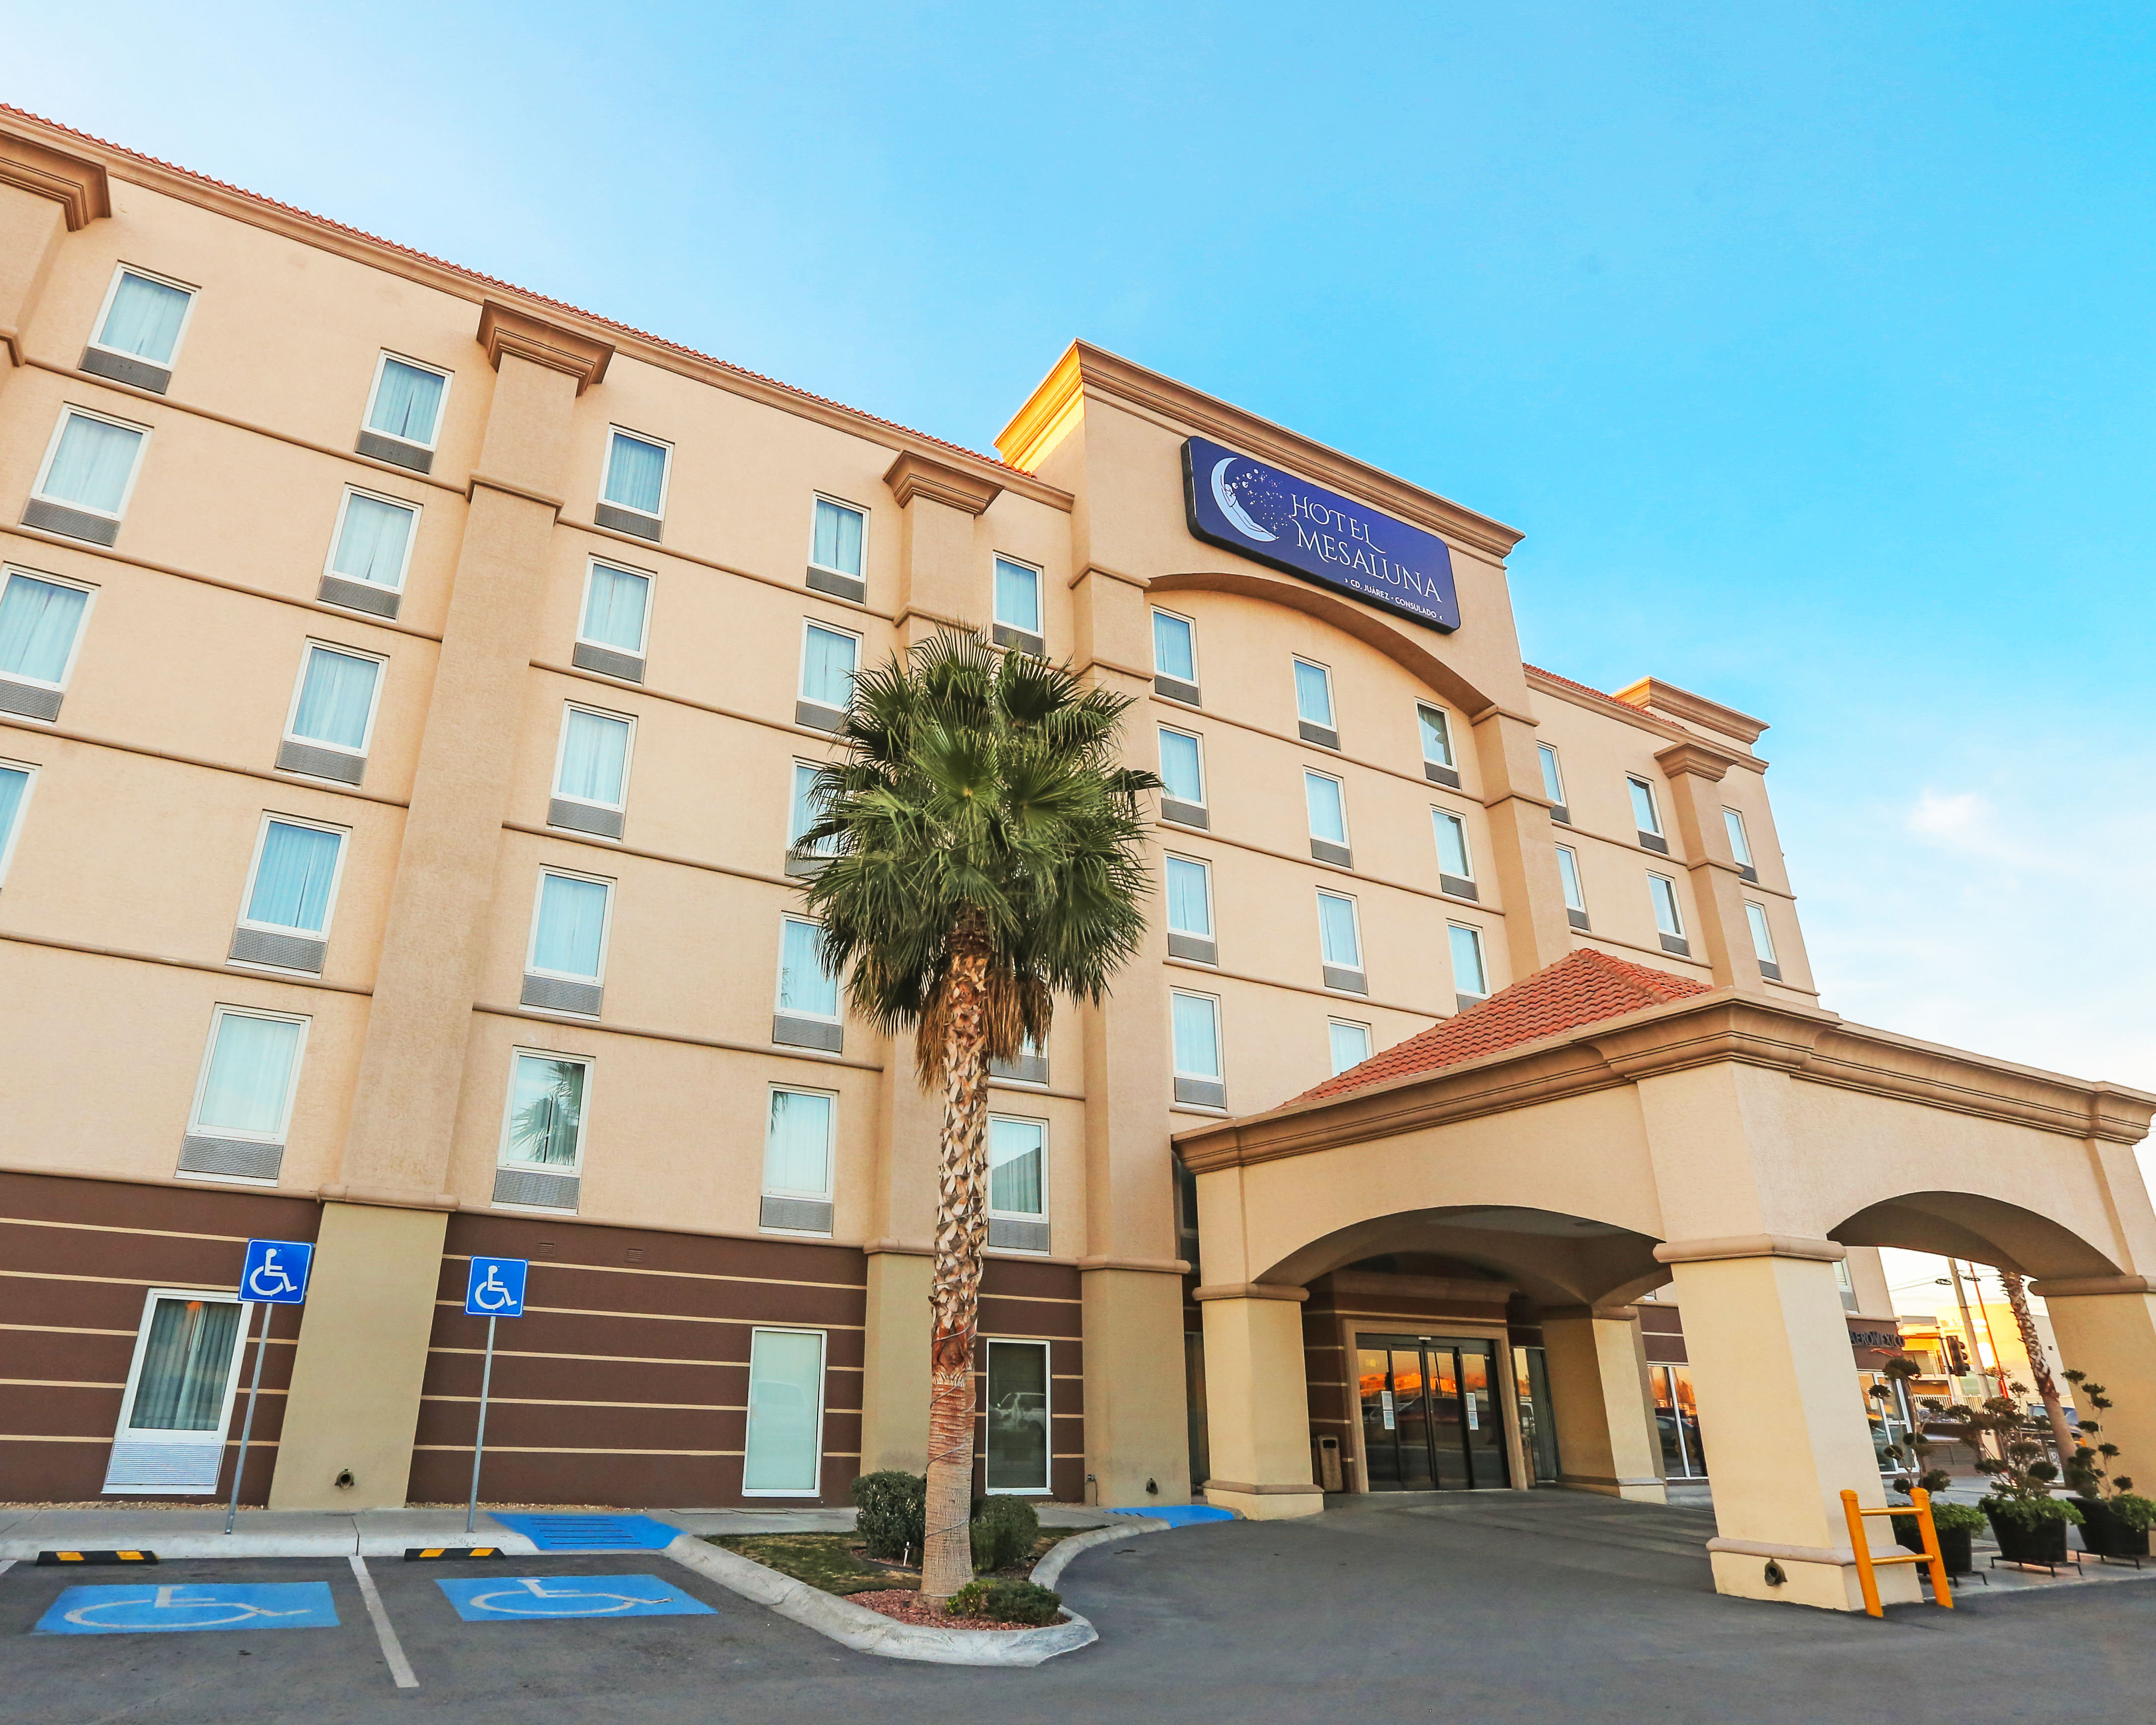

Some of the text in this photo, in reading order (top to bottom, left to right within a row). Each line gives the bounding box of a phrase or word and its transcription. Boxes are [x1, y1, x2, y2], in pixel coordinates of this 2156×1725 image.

[1292, 493, 1386, 553] HOTEL
[1292, 519, 1443, 603] MESALUNA
[1350, 579, 1437, 619] CD. JUÁREZ CONSULADO
